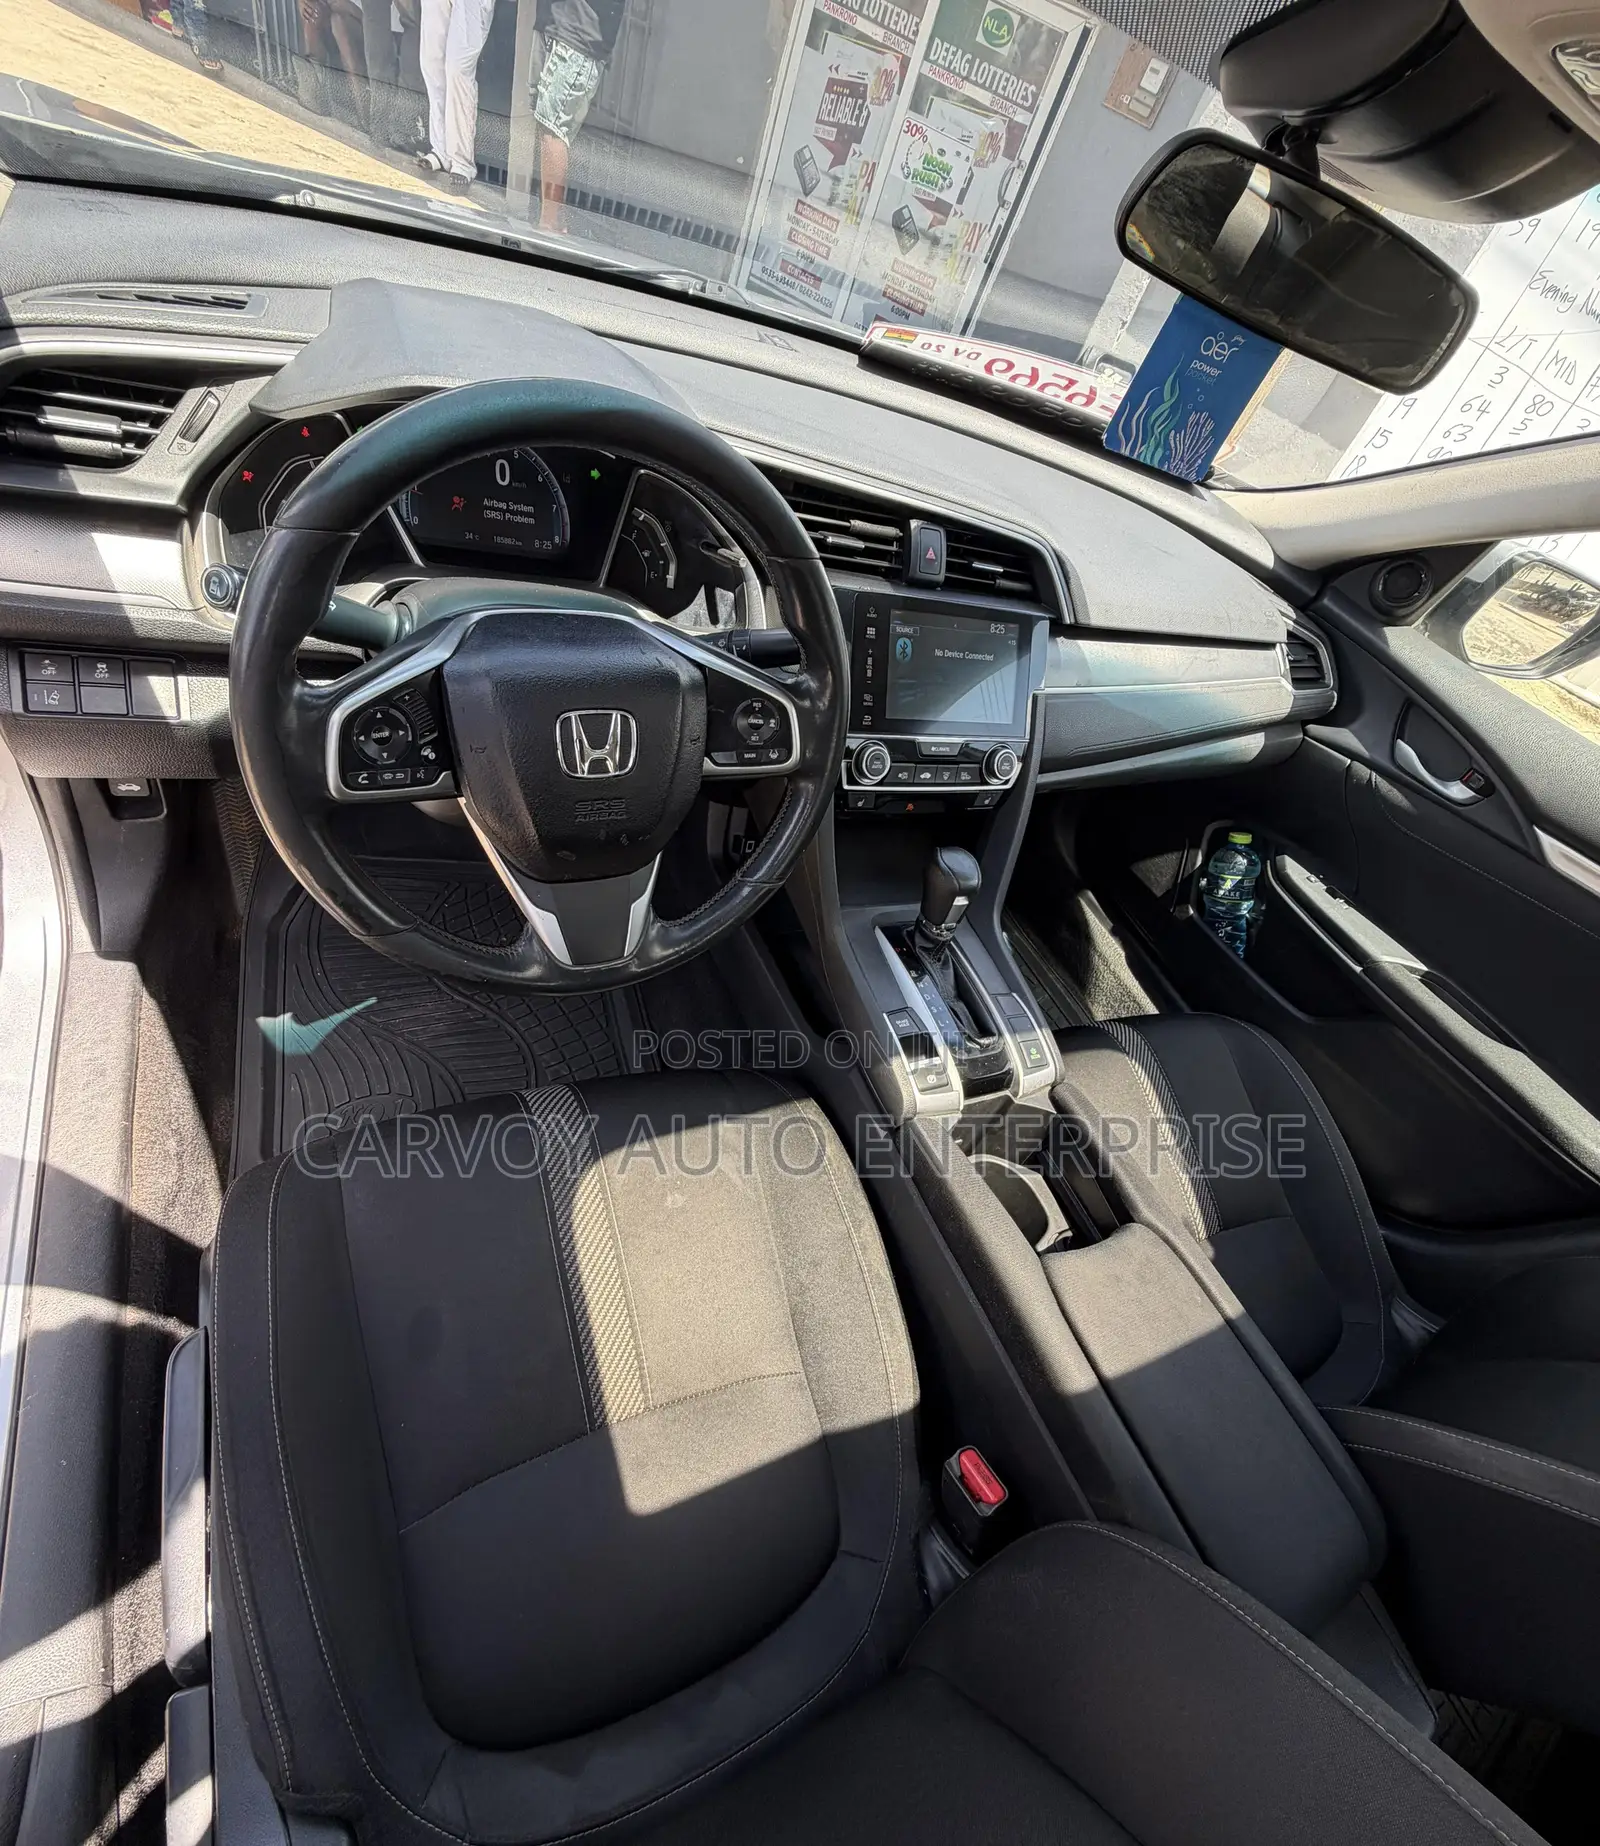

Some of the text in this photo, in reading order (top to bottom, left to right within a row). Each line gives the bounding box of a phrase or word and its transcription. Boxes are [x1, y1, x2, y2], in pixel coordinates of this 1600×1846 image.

[823, 0, 858, 25] PANKRONO
[882, 31, 911, 52] BRANCH
[862, 0, 921, 41] LOTTERIE
[984, 16, 1009, 38] NLA
[929, 37, 1037, 107] DEFAG LOTTERIES
[928, 65, 1018, 119] PANKRONO BRANCH
[819, 93, 863, 126] RELIABLE
[903, 120, 928, 143] 30%
[922, 153, 953, 178] NOON
[911, 168, 941, 189] RUSH
[787, 213, 810, 231] MONDAY
[812, 228, 840, 246] SATURDAY
[823, 215, 838, 231] DAYS
[791, 232, 829, 257] CLOSING TIME
[787, 264, 815, 285] CONTACTS
[882, 271, 905, 289] MONDAY
[908, 284, 936, 303] SATURDAY
[1529, 269, 1578, 314] Evening
[1190, 360, 1222, 377] power
[1490, 366, 1509, 384] 3
[1545, 349, 1577, 385] MID
[1185, 369, 1216, 386] pocket
[1388, 396, 1417, 420] 19
[1460, 394, 1491, 421] 64
[1525, 394, 1554, 417] 80
[1443, 423, 1473, 442] 63
[1513, 418, 1533, 431] 5
[1364, 427, 1392, 449] 15
[513, 450, 519, 459] 5
[495, 458, 510, 486] 0
[537, 474, 543, 483] 6
[512, 481, 527, 489] km/h
[483, 498, 534, 514] Airbag System
[552, 505, 557, 513] 7
[413, 516, 419, 525] 0
[483, 510, 535, 525] (SRS) Problem
[534, 539, 552, 550] 8:25
[554, 536, 560, 544] 8
[650, 571, 655, 579] E
[895, 626, 914, 634] SOURCE
[989, 623, 1005, 634] 8:25
[934, 648, 994, 661] No Device Connected
[372, 731, 390, 739] ENTER
[575, 799, 626, 812] SRS
[575, 811, 627, 822] AIRBAG
[1213, 889, 1240, 897] AWAKE
